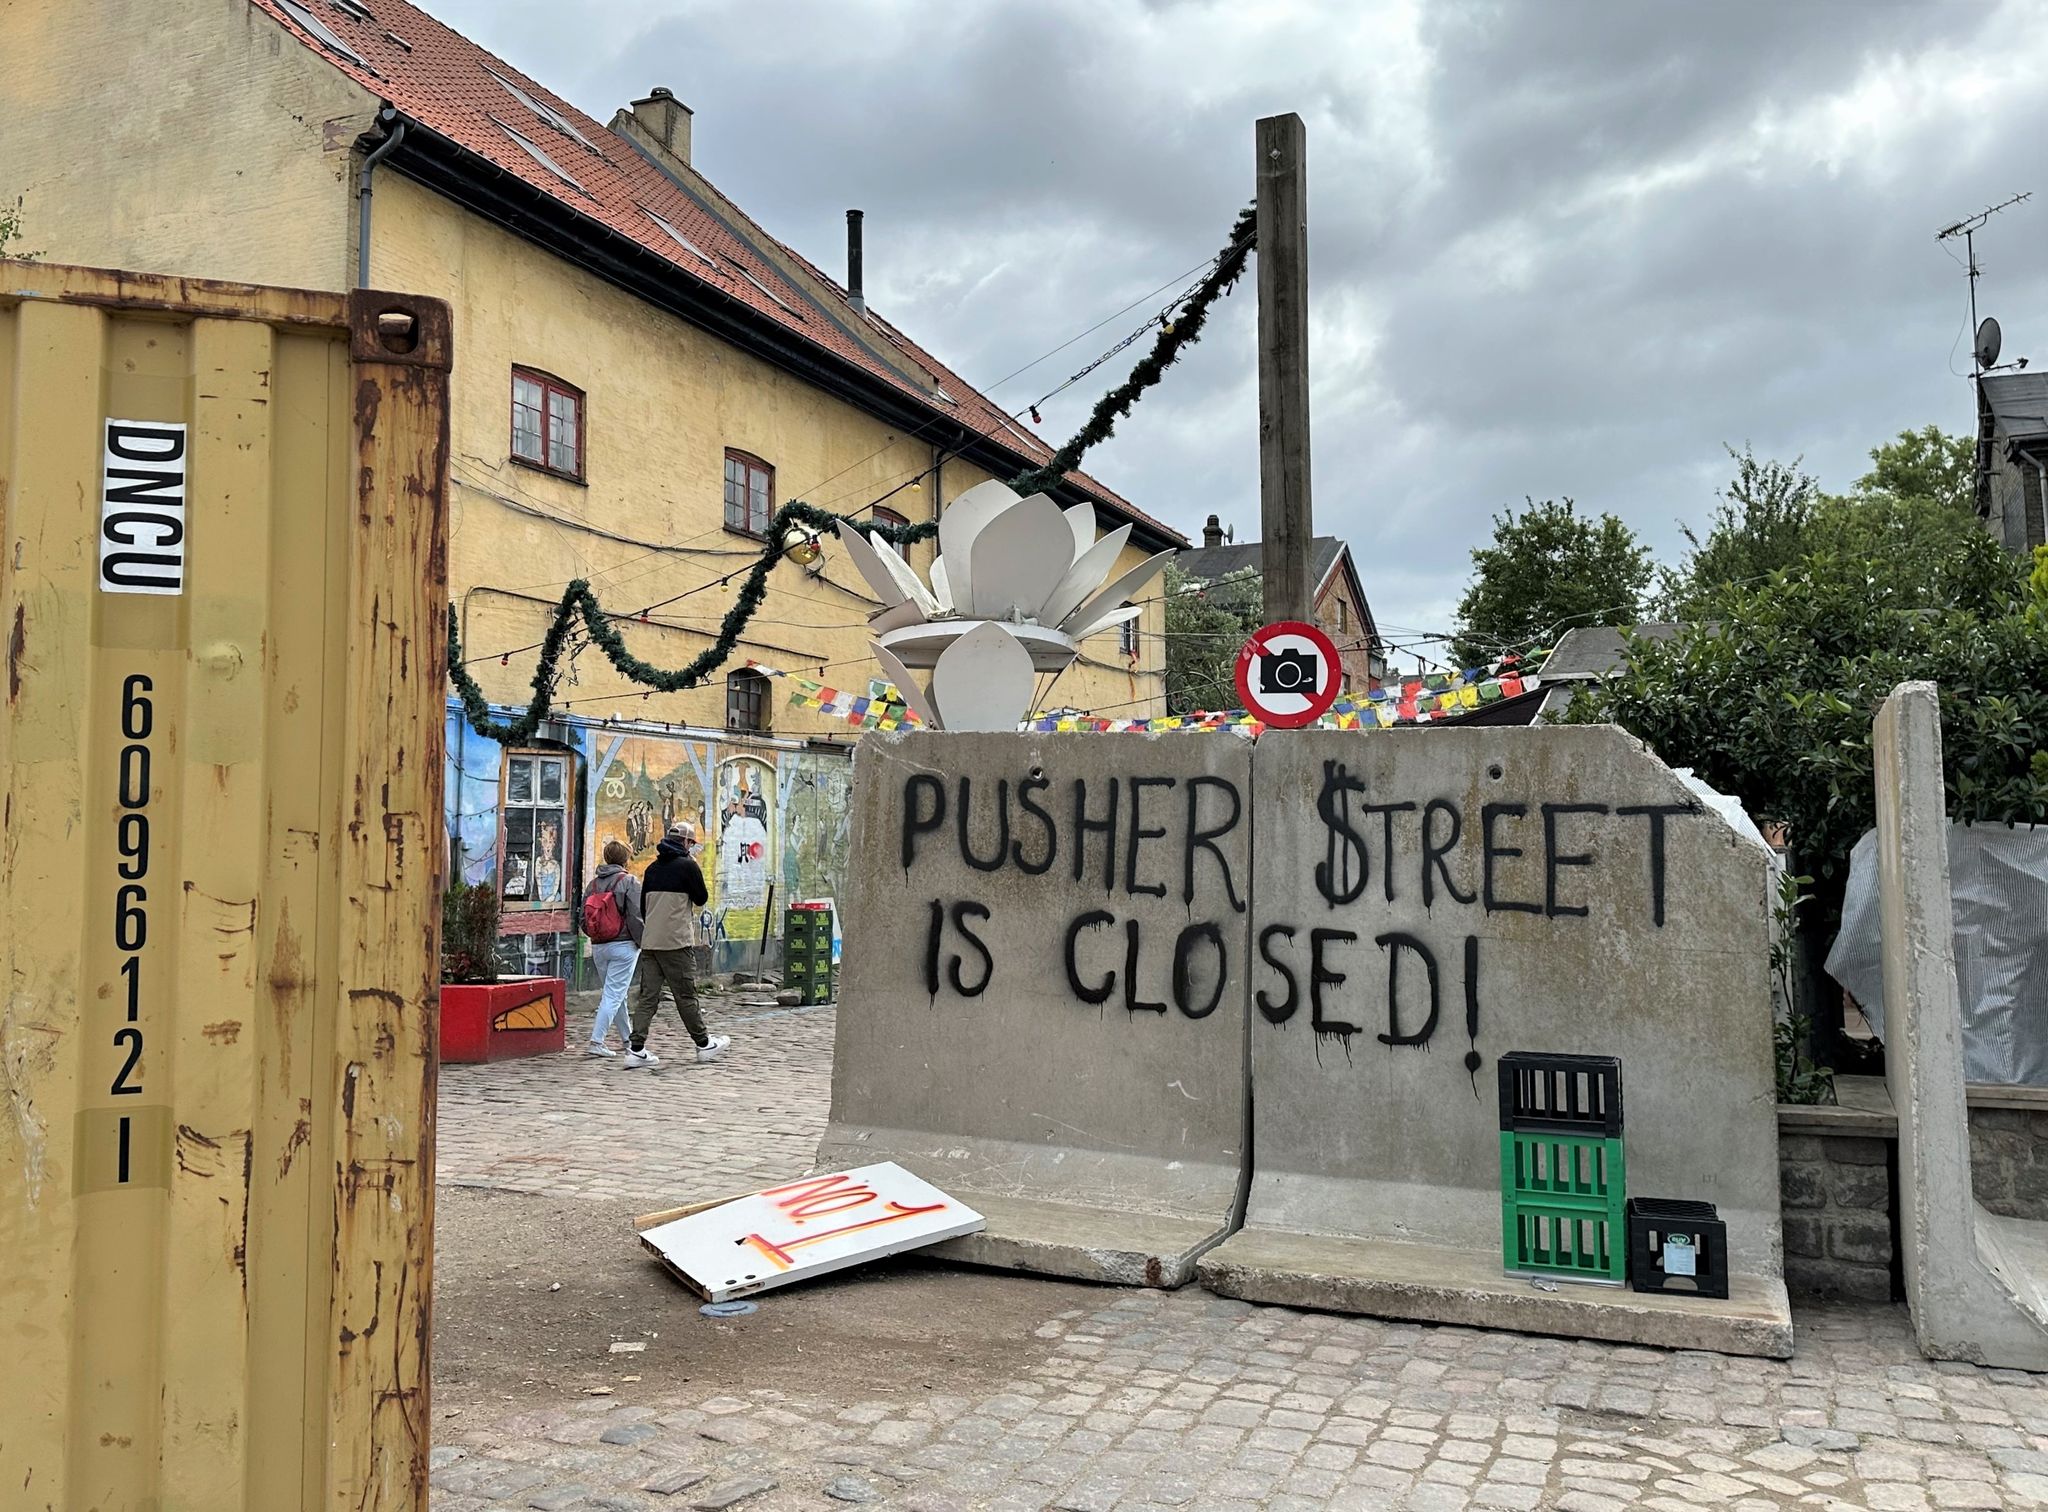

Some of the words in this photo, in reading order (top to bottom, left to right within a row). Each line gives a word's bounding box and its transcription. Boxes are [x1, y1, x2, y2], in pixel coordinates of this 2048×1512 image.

[102, 425, 185, 589] DNCU
[902, 773, 1247, 915] PUSHER
[1314, 759, 1702, 929] $TREET
[925, 899, 994, 1004] IS
[1064, 909, 1480, 1075] CLOSED!
